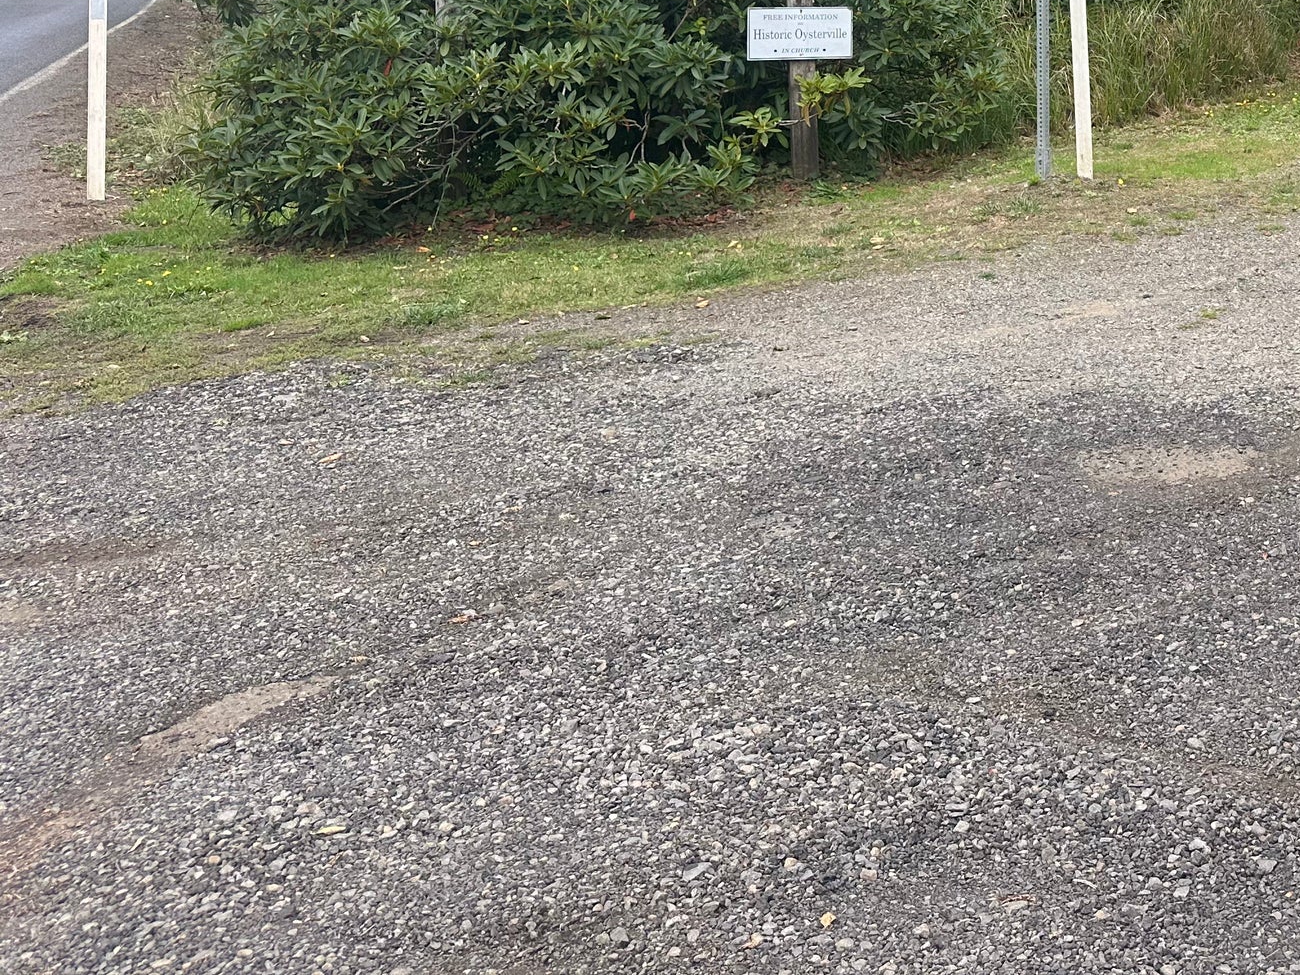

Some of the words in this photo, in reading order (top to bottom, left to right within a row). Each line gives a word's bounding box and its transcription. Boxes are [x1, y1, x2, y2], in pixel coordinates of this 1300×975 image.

[784, 13, 838, 21] INFORMATION
[753, 28, 792, 40] Historic
[794, 28, 848, 41] Oysterville
